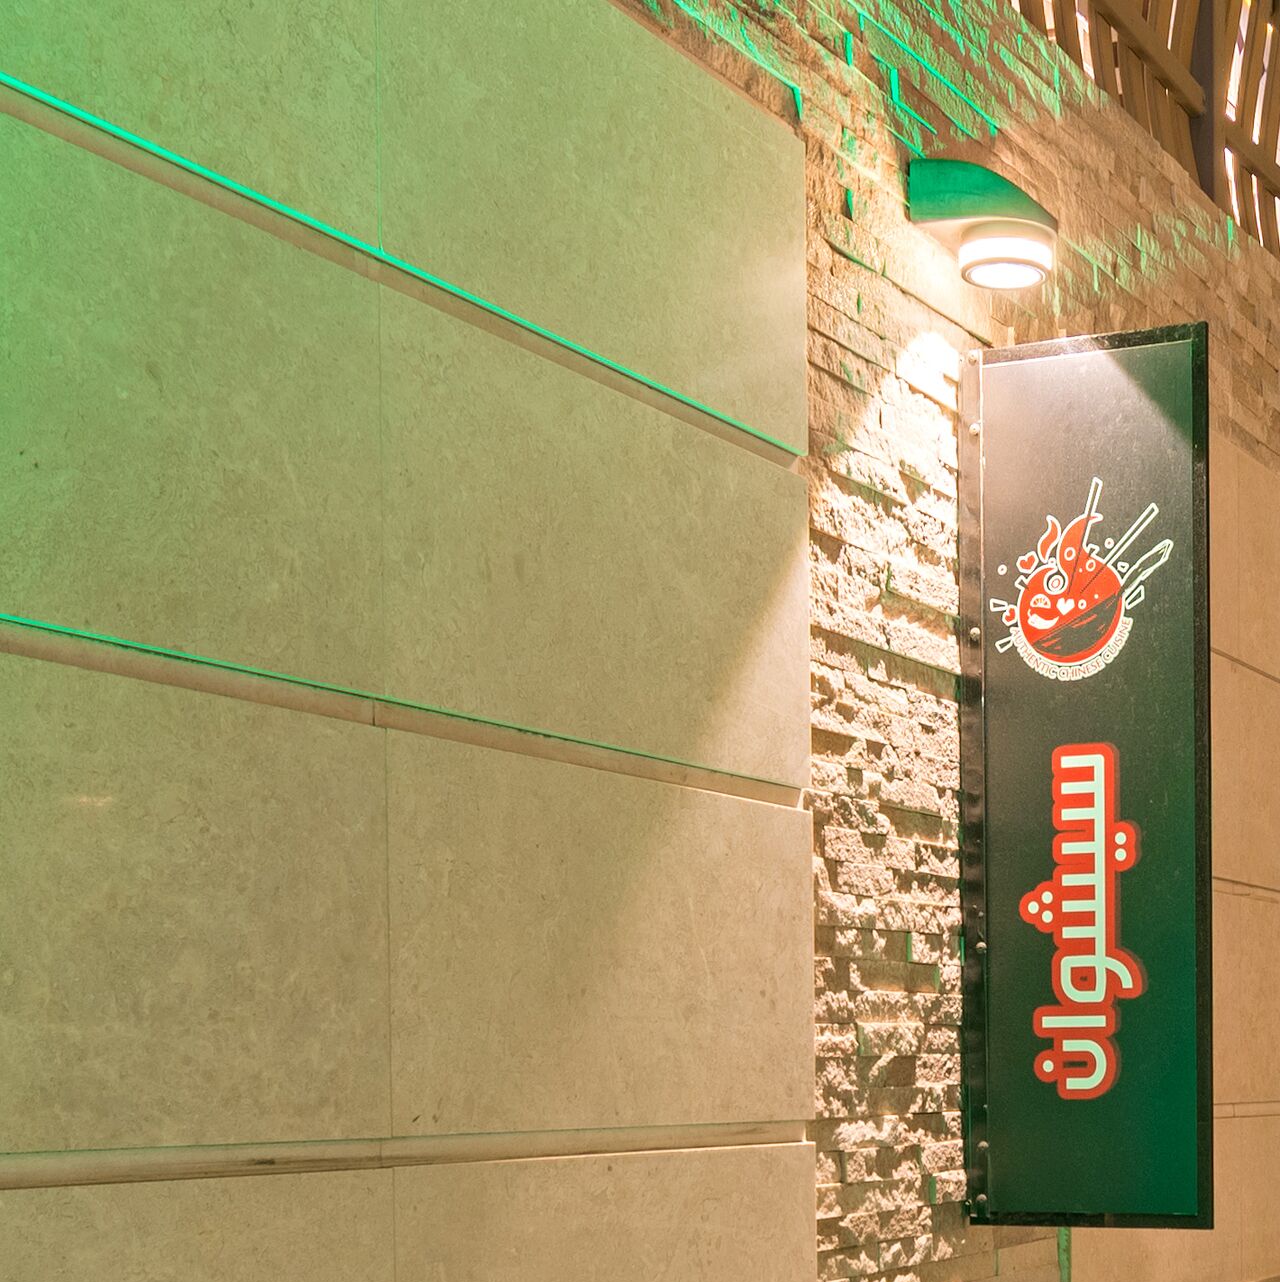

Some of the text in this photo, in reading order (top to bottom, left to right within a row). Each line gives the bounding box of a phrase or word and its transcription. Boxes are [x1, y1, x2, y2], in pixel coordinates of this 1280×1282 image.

[1011, 617, 1132, 680] AUTHENTIC CHINESE CUISINE
[1025, 751, 1135, 1092] سيشوان
